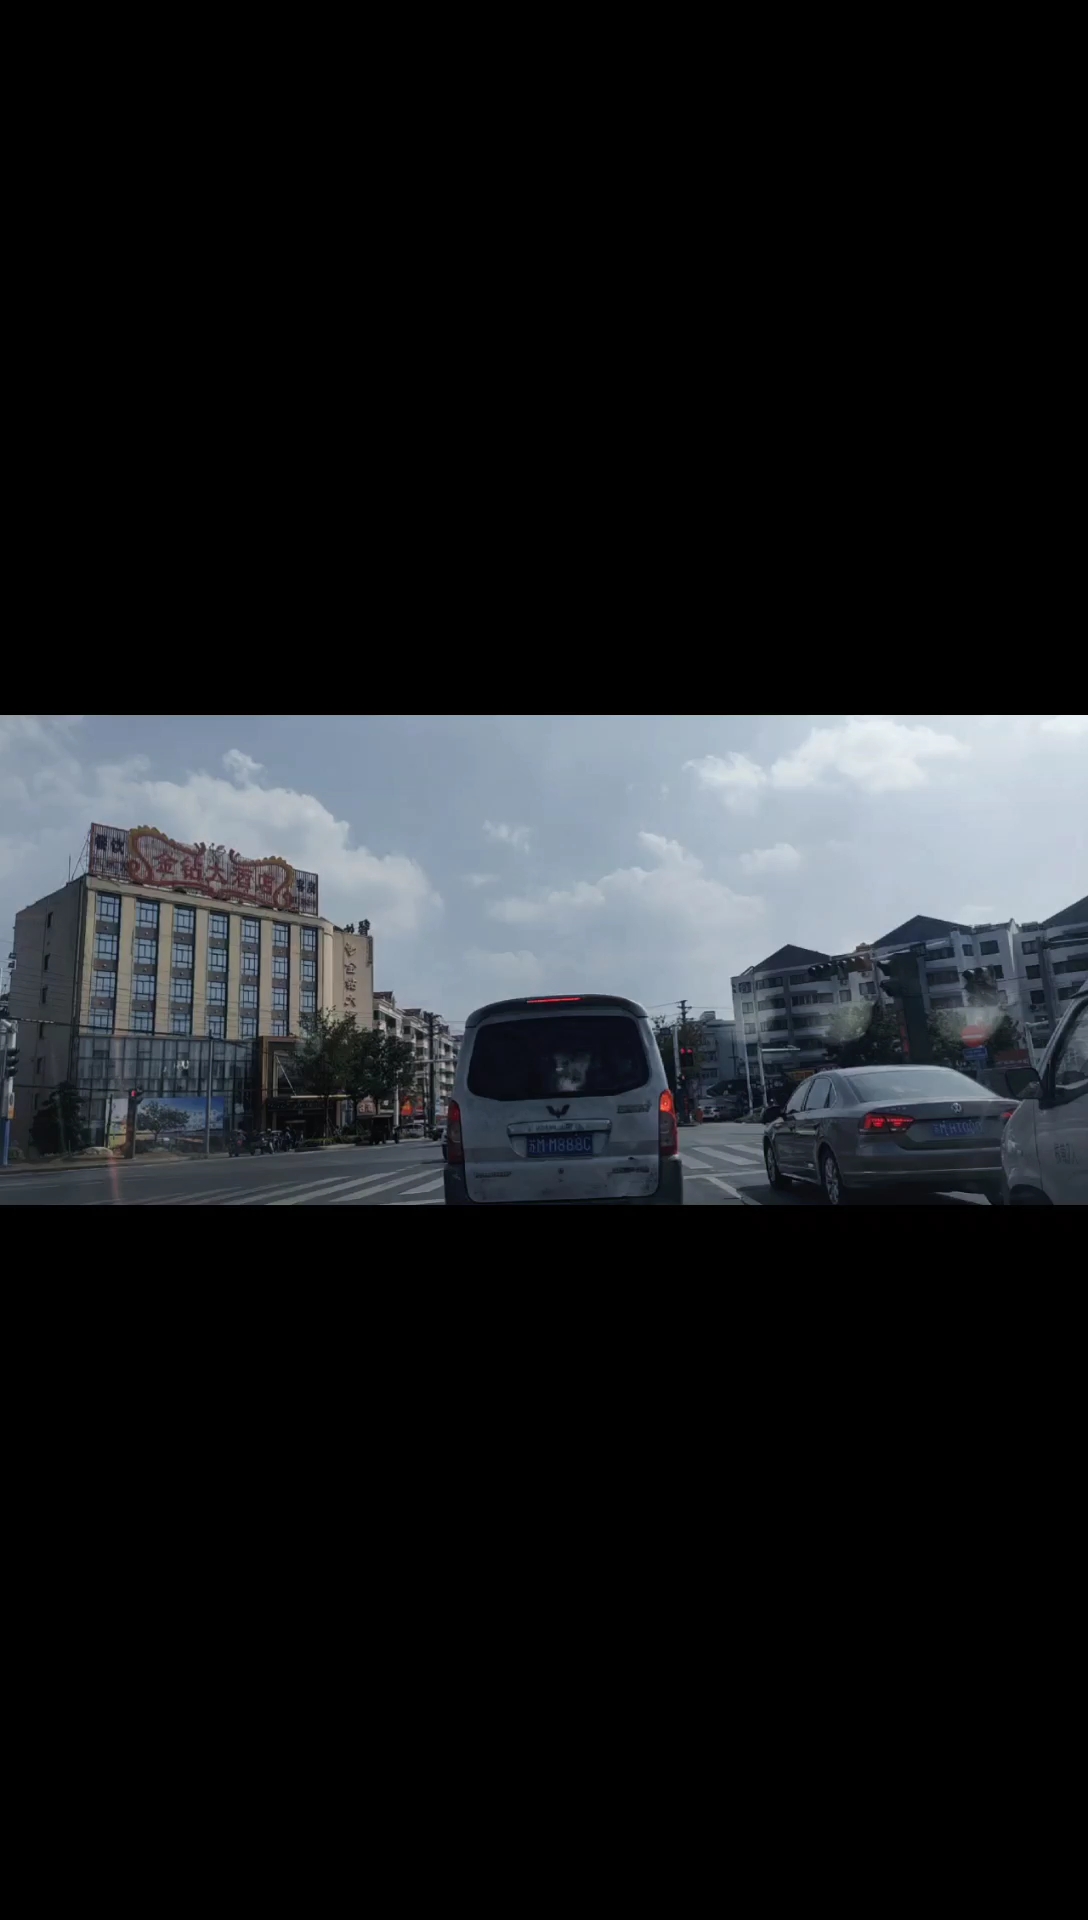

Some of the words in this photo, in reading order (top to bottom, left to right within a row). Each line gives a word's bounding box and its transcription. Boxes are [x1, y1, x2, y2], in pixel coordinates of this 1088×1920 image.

[153, 850, 276, 895] 金钻大酒店
